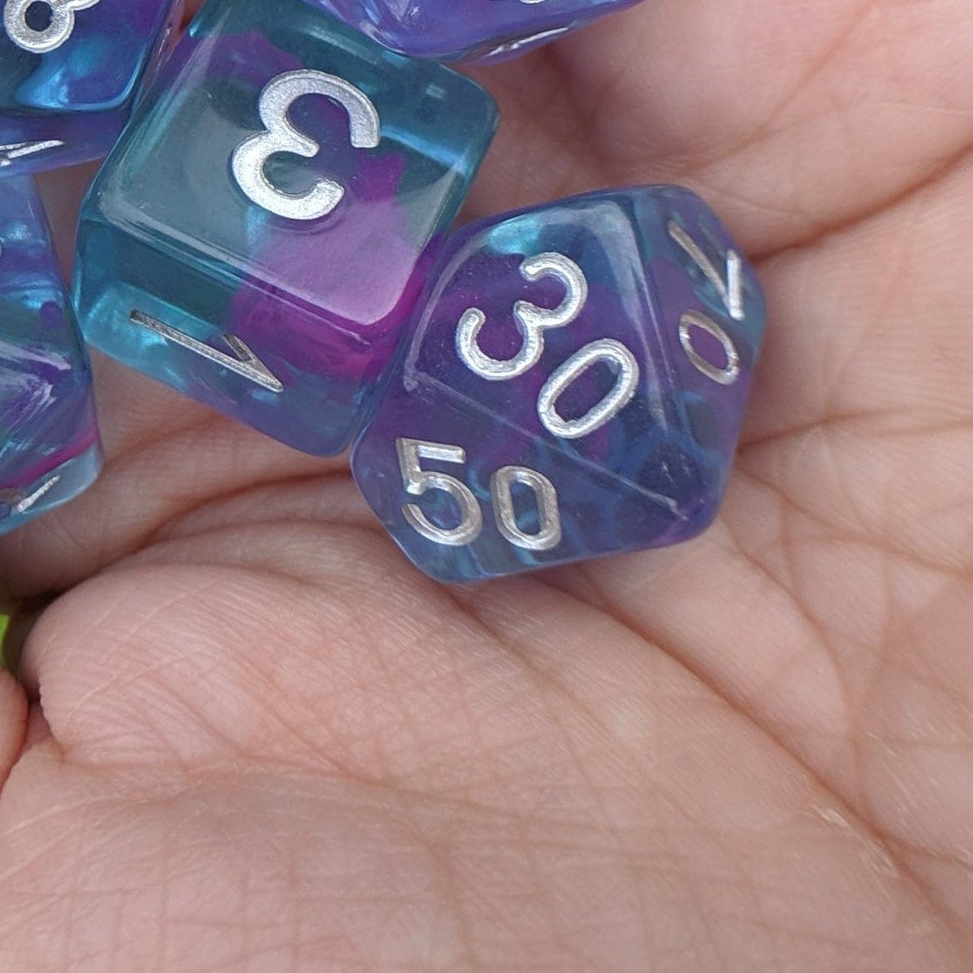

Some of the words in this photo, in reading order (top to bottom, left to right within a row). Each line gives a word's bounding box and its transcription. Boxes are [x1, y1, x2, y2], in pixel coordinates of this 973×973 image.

[232, 68, 381, 221] 3
[456, 251, 640, 439] 30
[395, 437, 563, 551] 50
